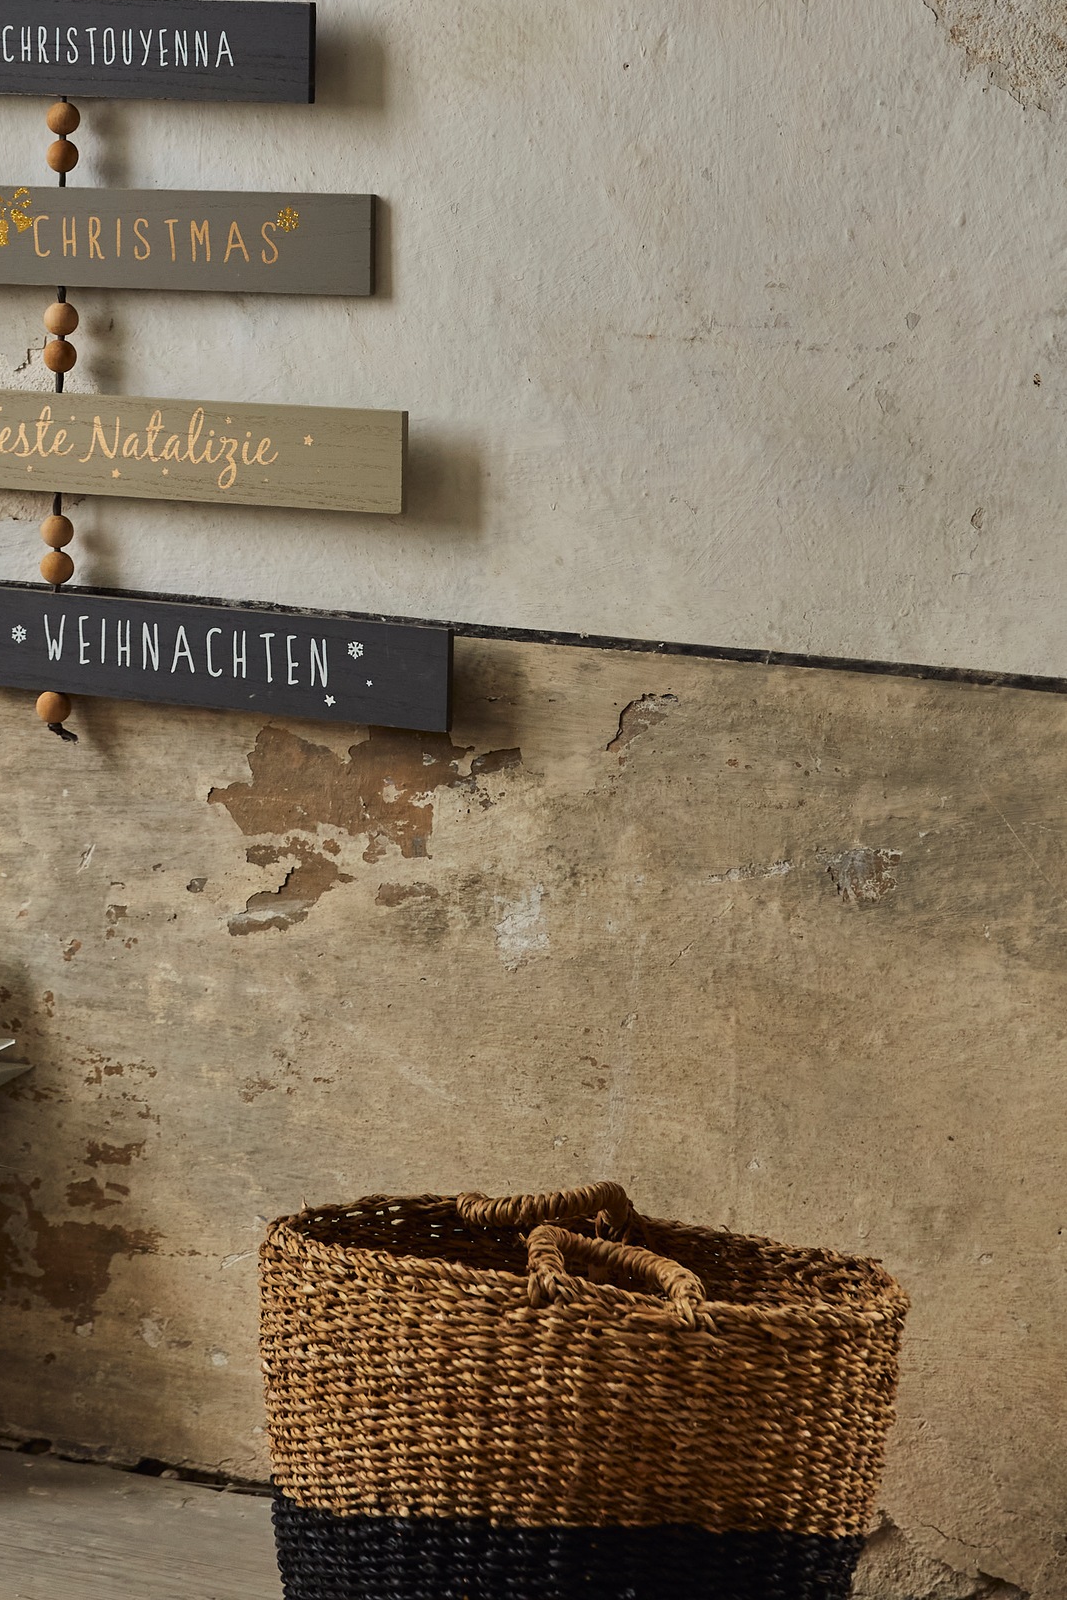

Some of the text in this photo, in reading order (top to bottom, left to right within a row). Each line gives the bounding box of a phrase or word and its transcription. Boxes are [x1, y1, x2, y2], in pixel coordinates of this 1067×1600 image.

[1, 25, 234, 67] CHRISTOUYENNA
[34, 215, 278, 264] CHRISTMAS
[78, 407, 279, 489] Natalizie
[43, 613, 329, 687] WEIHNACHTEN
